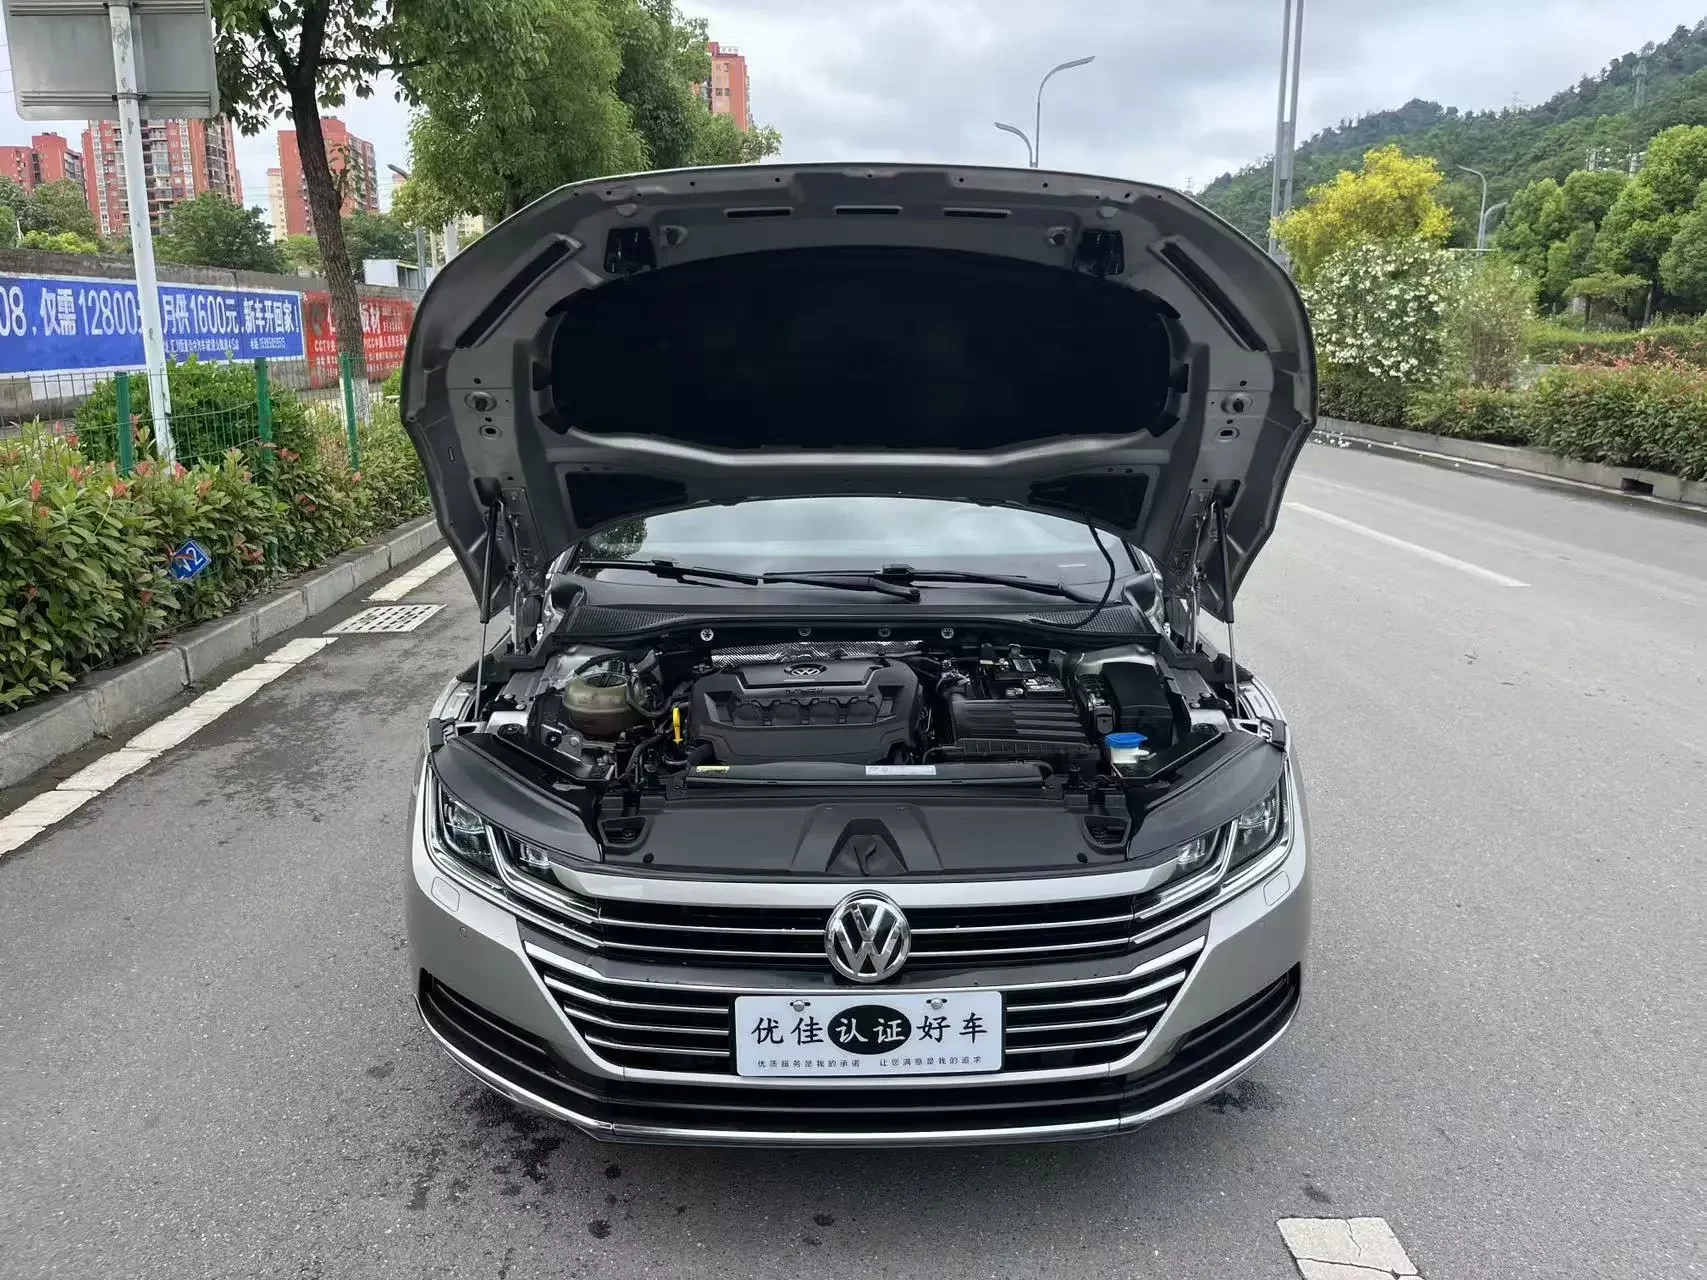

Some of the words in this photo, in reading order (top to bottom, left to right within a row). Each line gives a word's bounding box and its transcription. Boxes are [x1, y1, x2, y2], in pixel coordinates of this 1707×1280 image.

[757, 1059, 860, 1068] 优质服务是我的承诺
